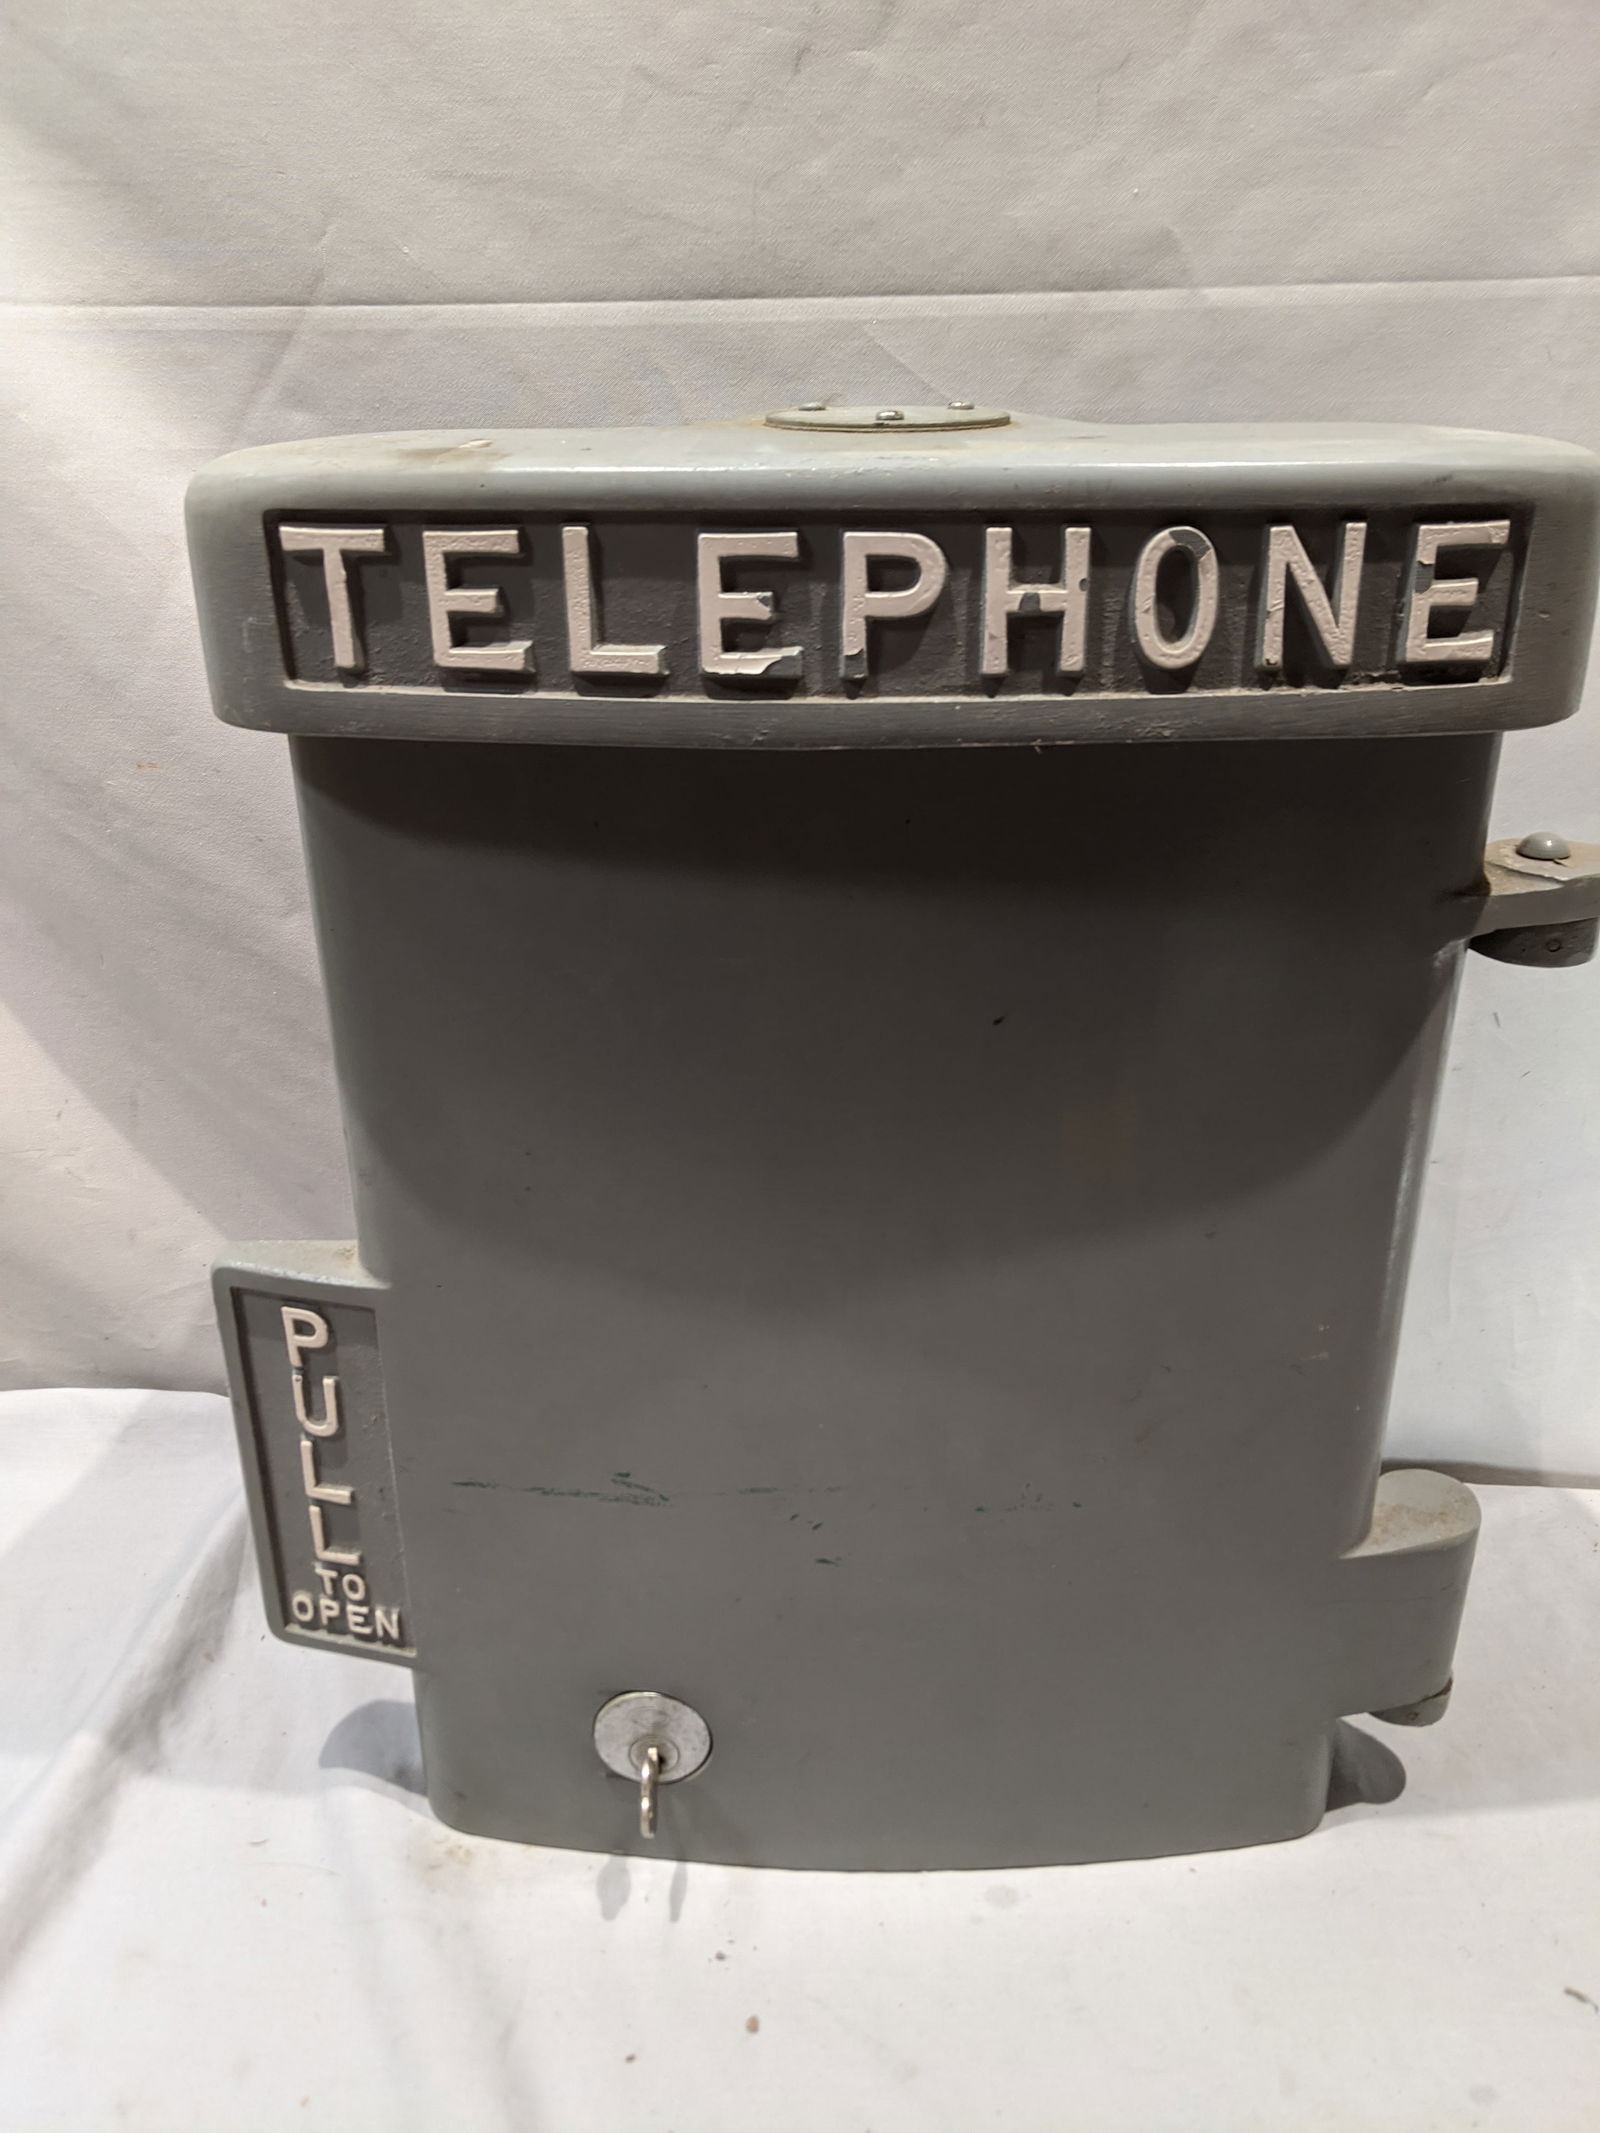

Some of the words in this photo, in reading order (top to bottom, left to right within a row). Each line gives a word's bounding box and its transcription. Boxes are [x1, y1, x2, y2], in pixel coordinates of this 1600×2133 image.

[278, 519, 1512, 679] TELEPHONE
[281, 1306, 360, 1565] PULL
[291, 1595, 400, 1641] OPEN
[315, 1567, 366, 1601] TO
